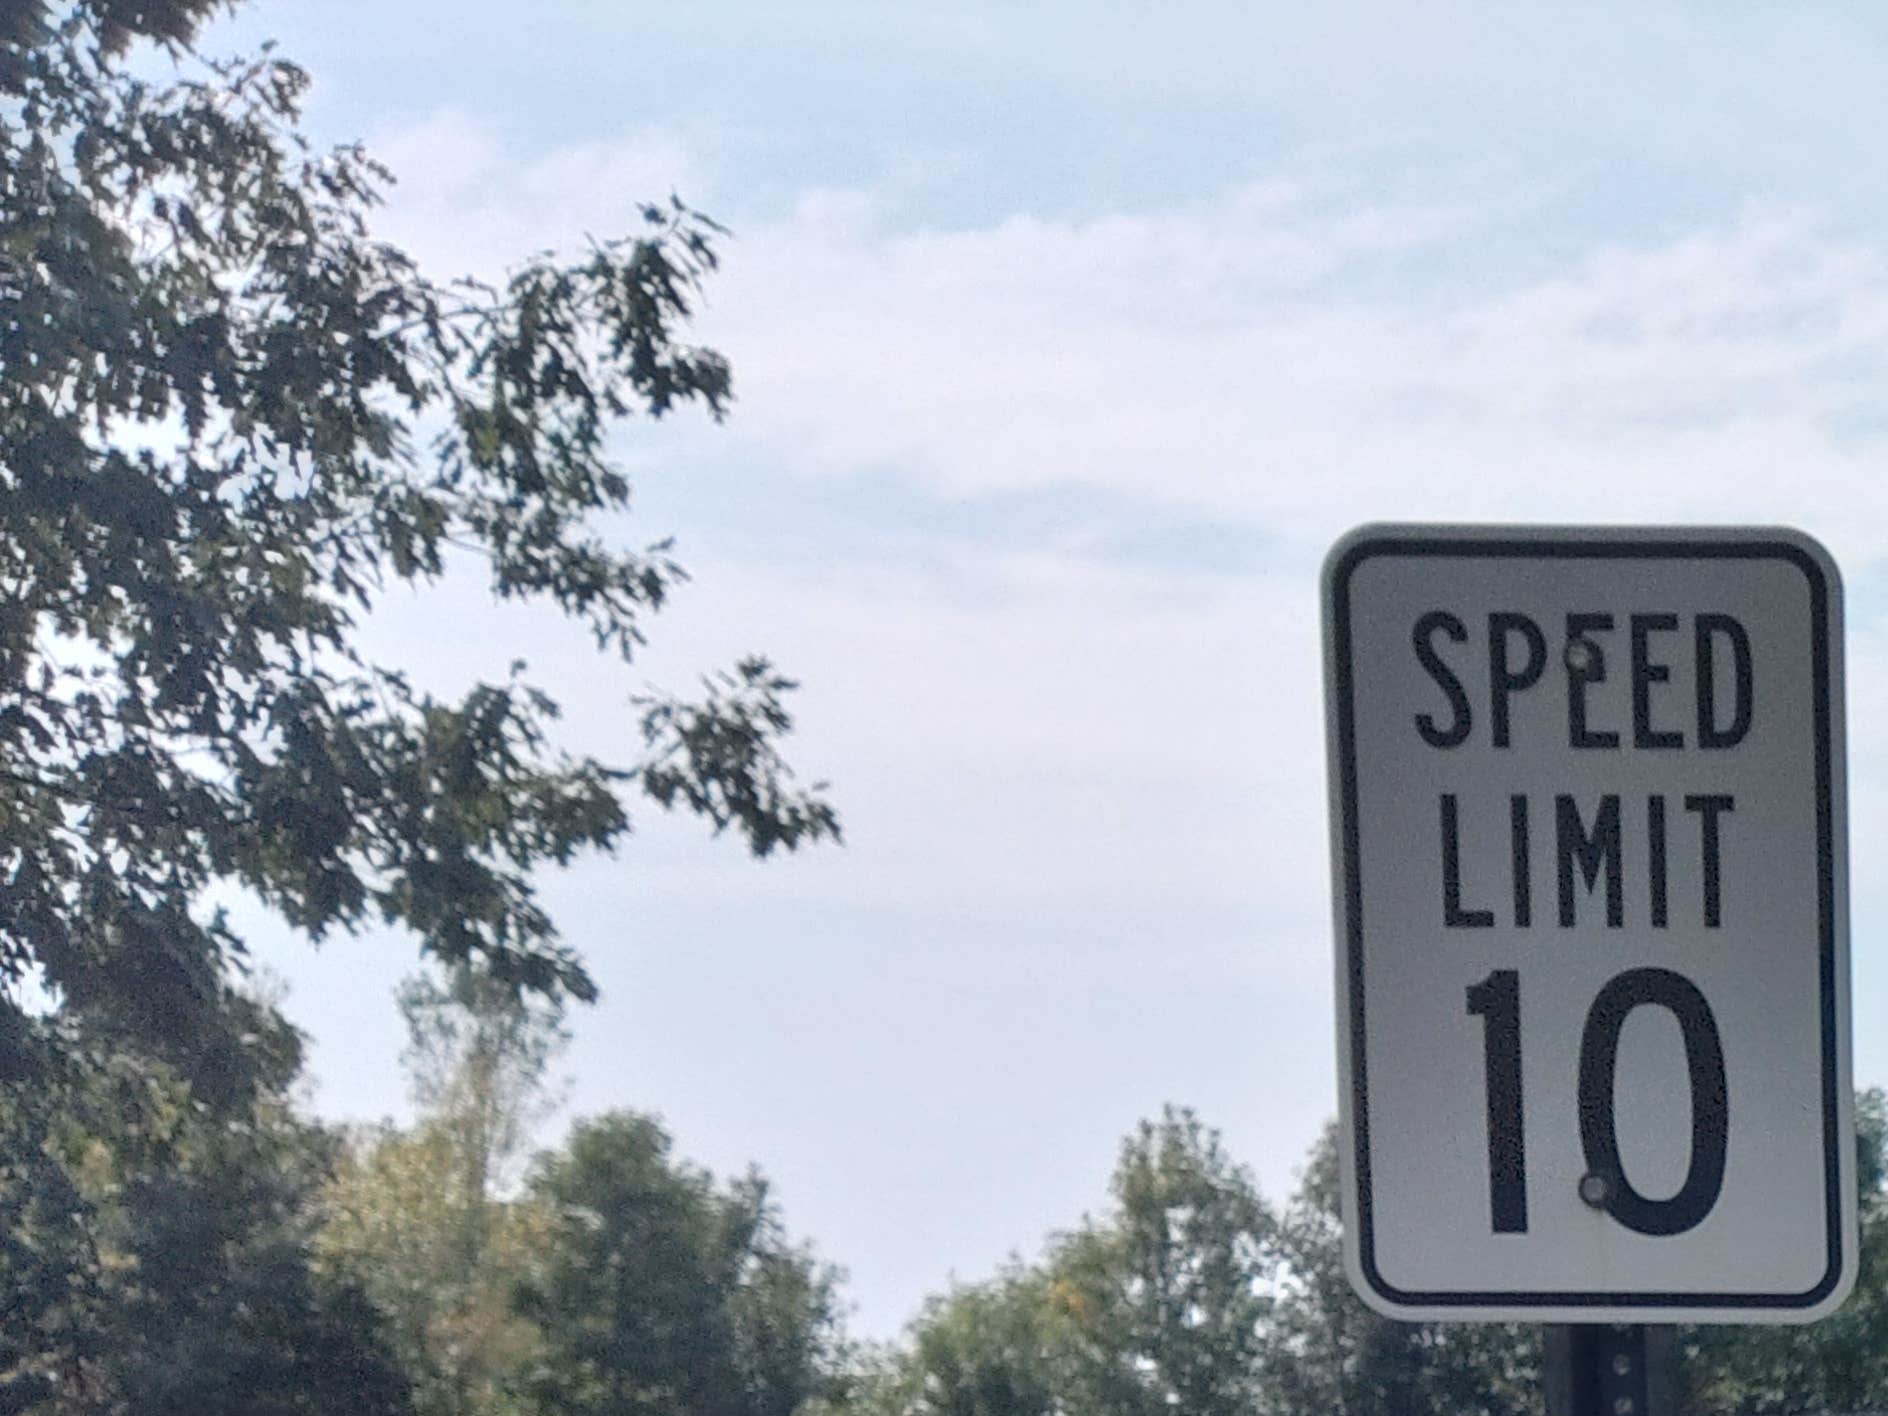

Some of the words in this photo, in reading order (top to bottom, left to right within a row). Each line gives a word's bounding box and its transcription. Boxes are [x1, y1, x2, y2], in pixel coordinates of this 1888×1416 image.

[1413, 611, 1754, 750] SPEED
[1440, 794, 1735, 928] LIMIT
[1466, 967, 1729, 1237] 10
